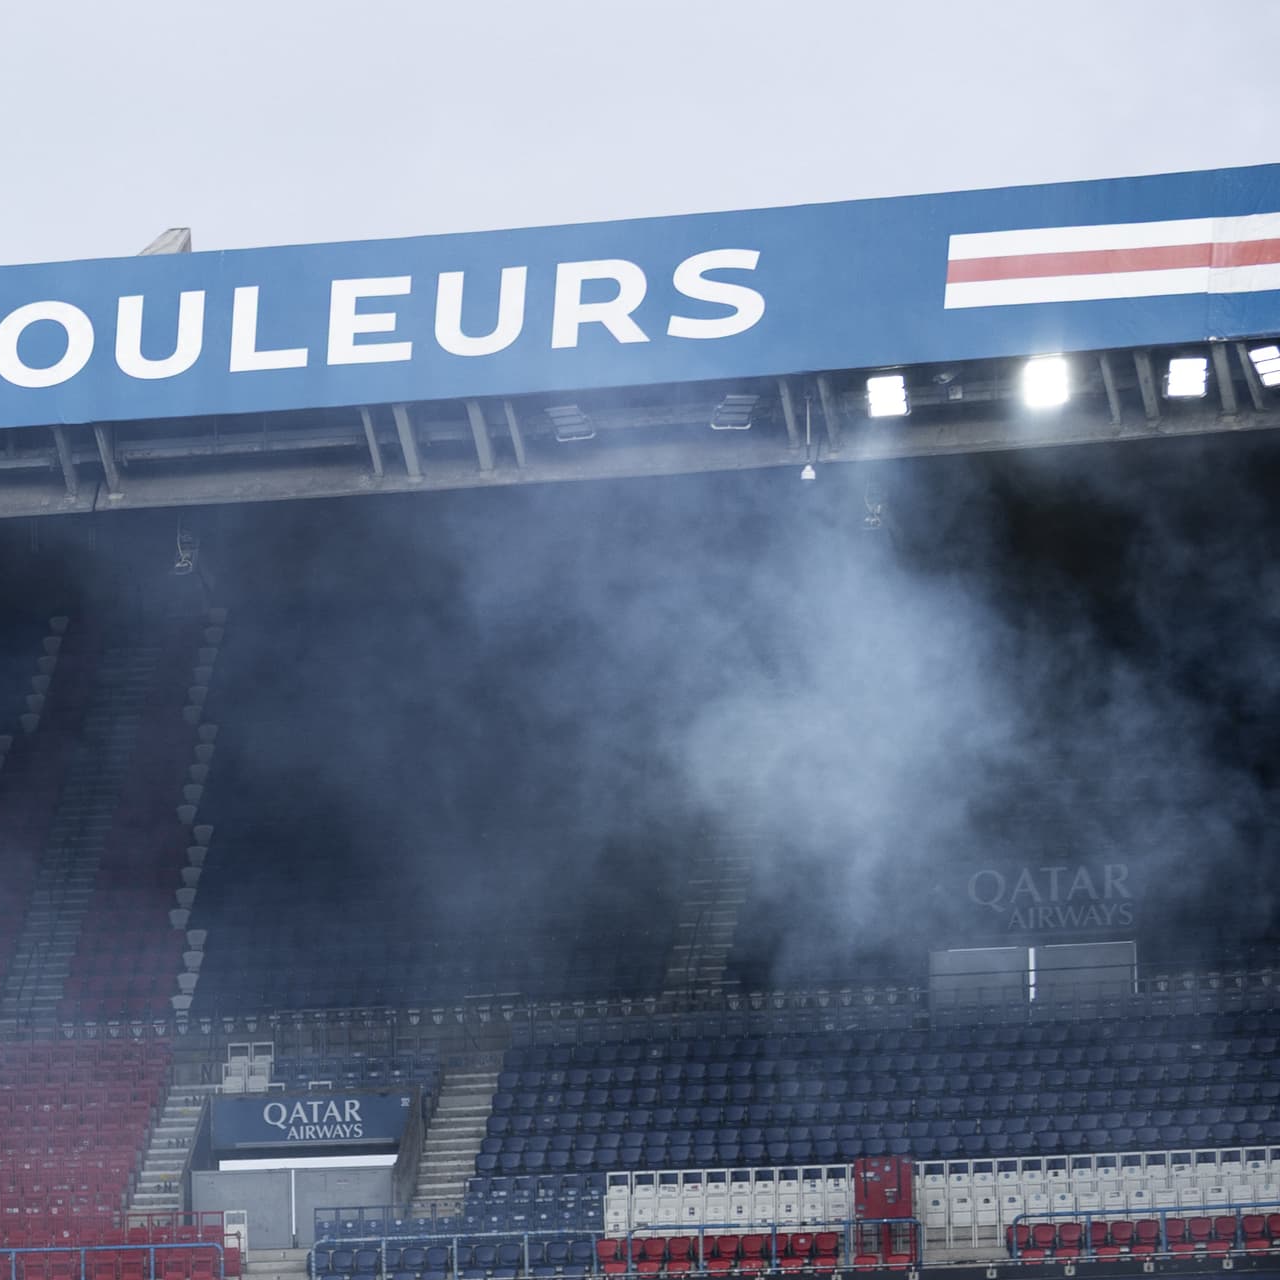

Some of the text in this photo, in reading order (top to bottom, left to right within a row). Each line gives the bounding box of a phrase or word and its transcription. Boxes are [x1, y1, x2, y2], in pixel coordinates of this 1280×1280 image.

[967, 863, 1133, 906] QATAR
[1007, 902, 1134, 931] AIRWAYS
[263, 1099, 362, 1130] QATAR
[286, 1123, 363, 1140] AIRWAYS
